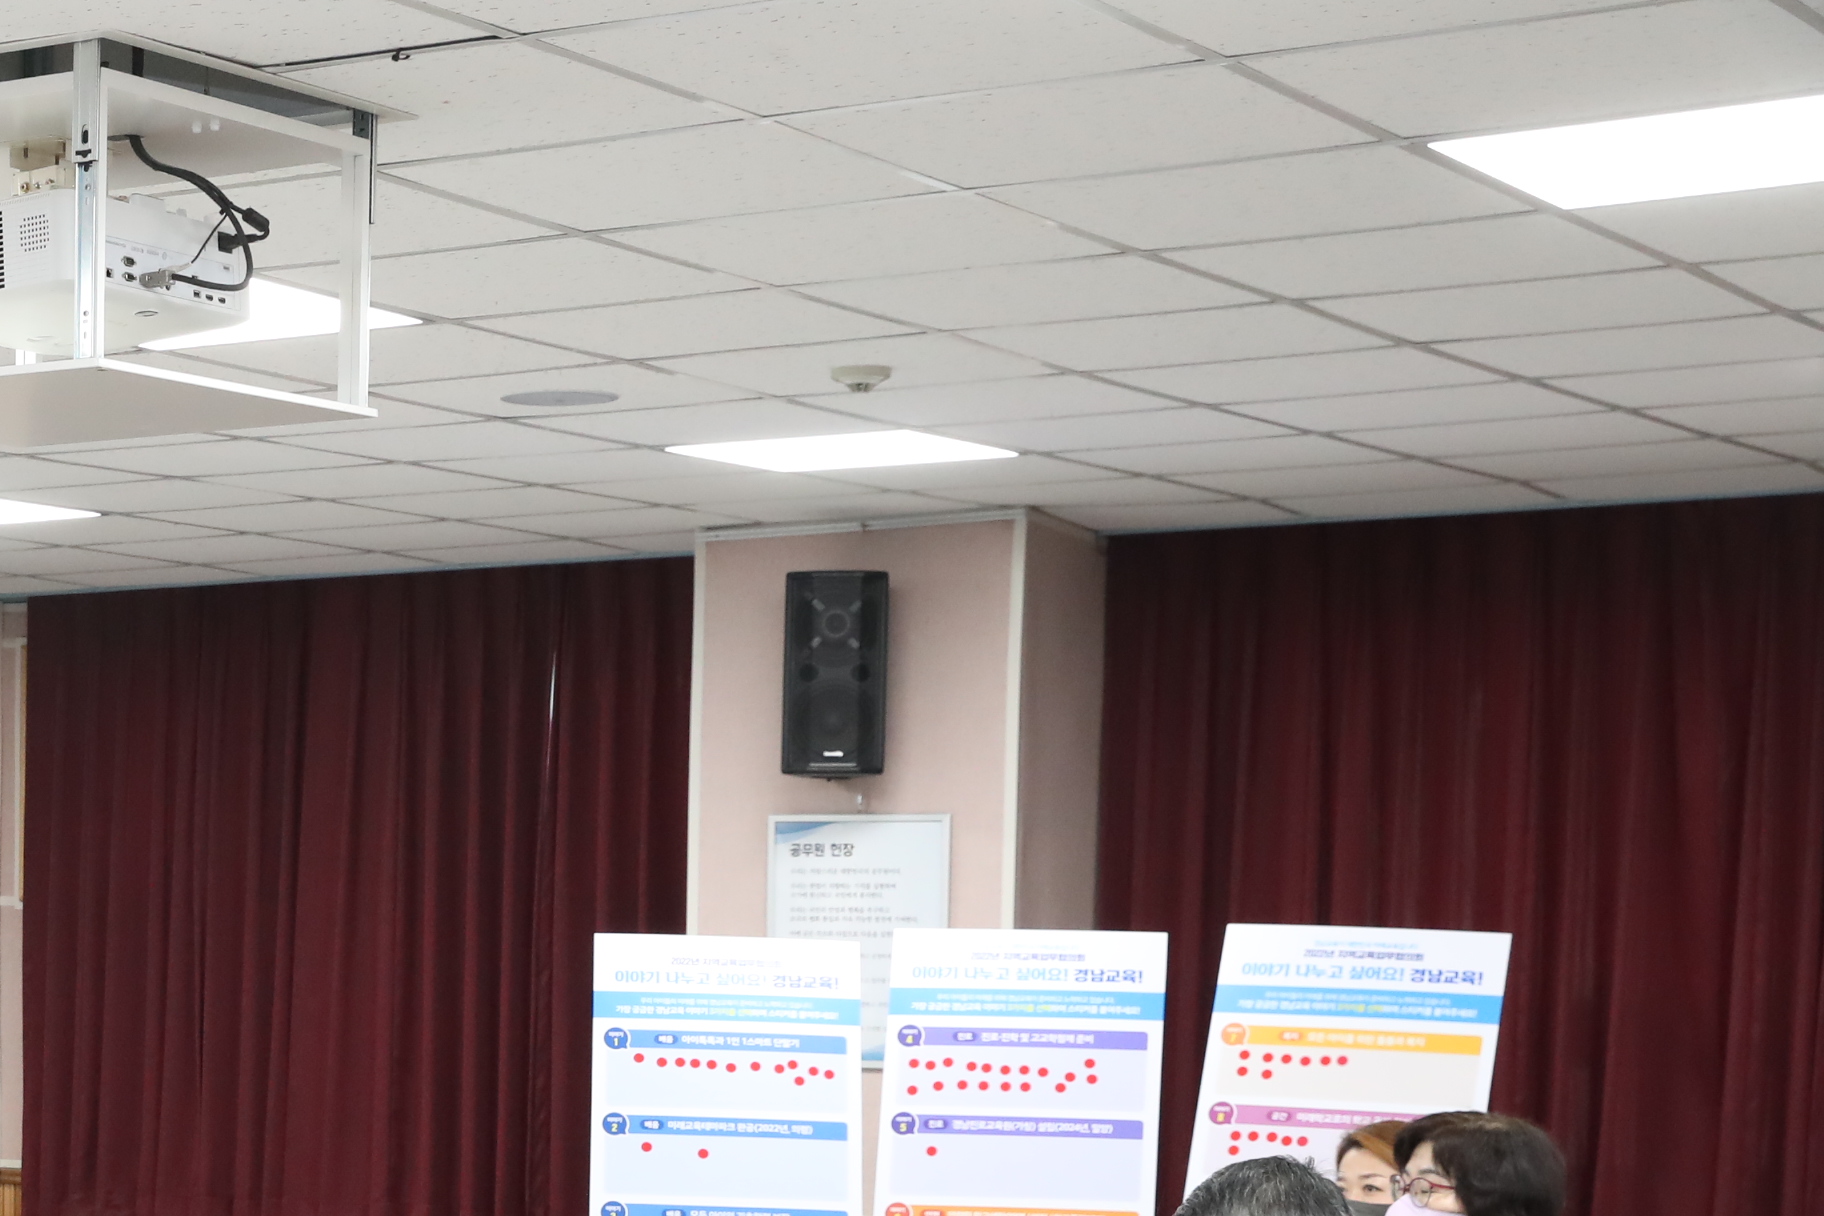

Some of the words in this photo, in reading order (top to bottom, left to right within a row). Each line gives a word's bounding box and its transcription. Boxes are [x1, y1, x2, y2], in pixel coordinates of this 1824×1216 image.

[790, 844, 825, 856] 공무원
[830, 844, 854, 856] 헌장
[671, 957, 699, 966] 2022년
[912, 966, 958, 979] 이야기
[964, 967, 1010, 980] 나누고
[1016, 968, 1068, 981] 싶어요!
[1074, 969, 1143, 984] 경남교육!
[1242, 962, 1290, 976] 이야기
[1296, 964, 1344, 979] 나누고
[1349, 966, 1405, 982] 싶어요!
[1411, 968, 1484, 986] 경남교육!
[615, 970, 660, 984] 이야기
[666, 971, 710, 985] 나누고
[716, 973, 766, 986] 싶어요!
[772, 975, 839, 990] 경남교육!
[655, 1007, 684, 1015] 경남교육
[613, 1038, 618, 1046] 1
[611, 1123, 618, 1132] 2
[900, 1122, 907, 1131] 5
